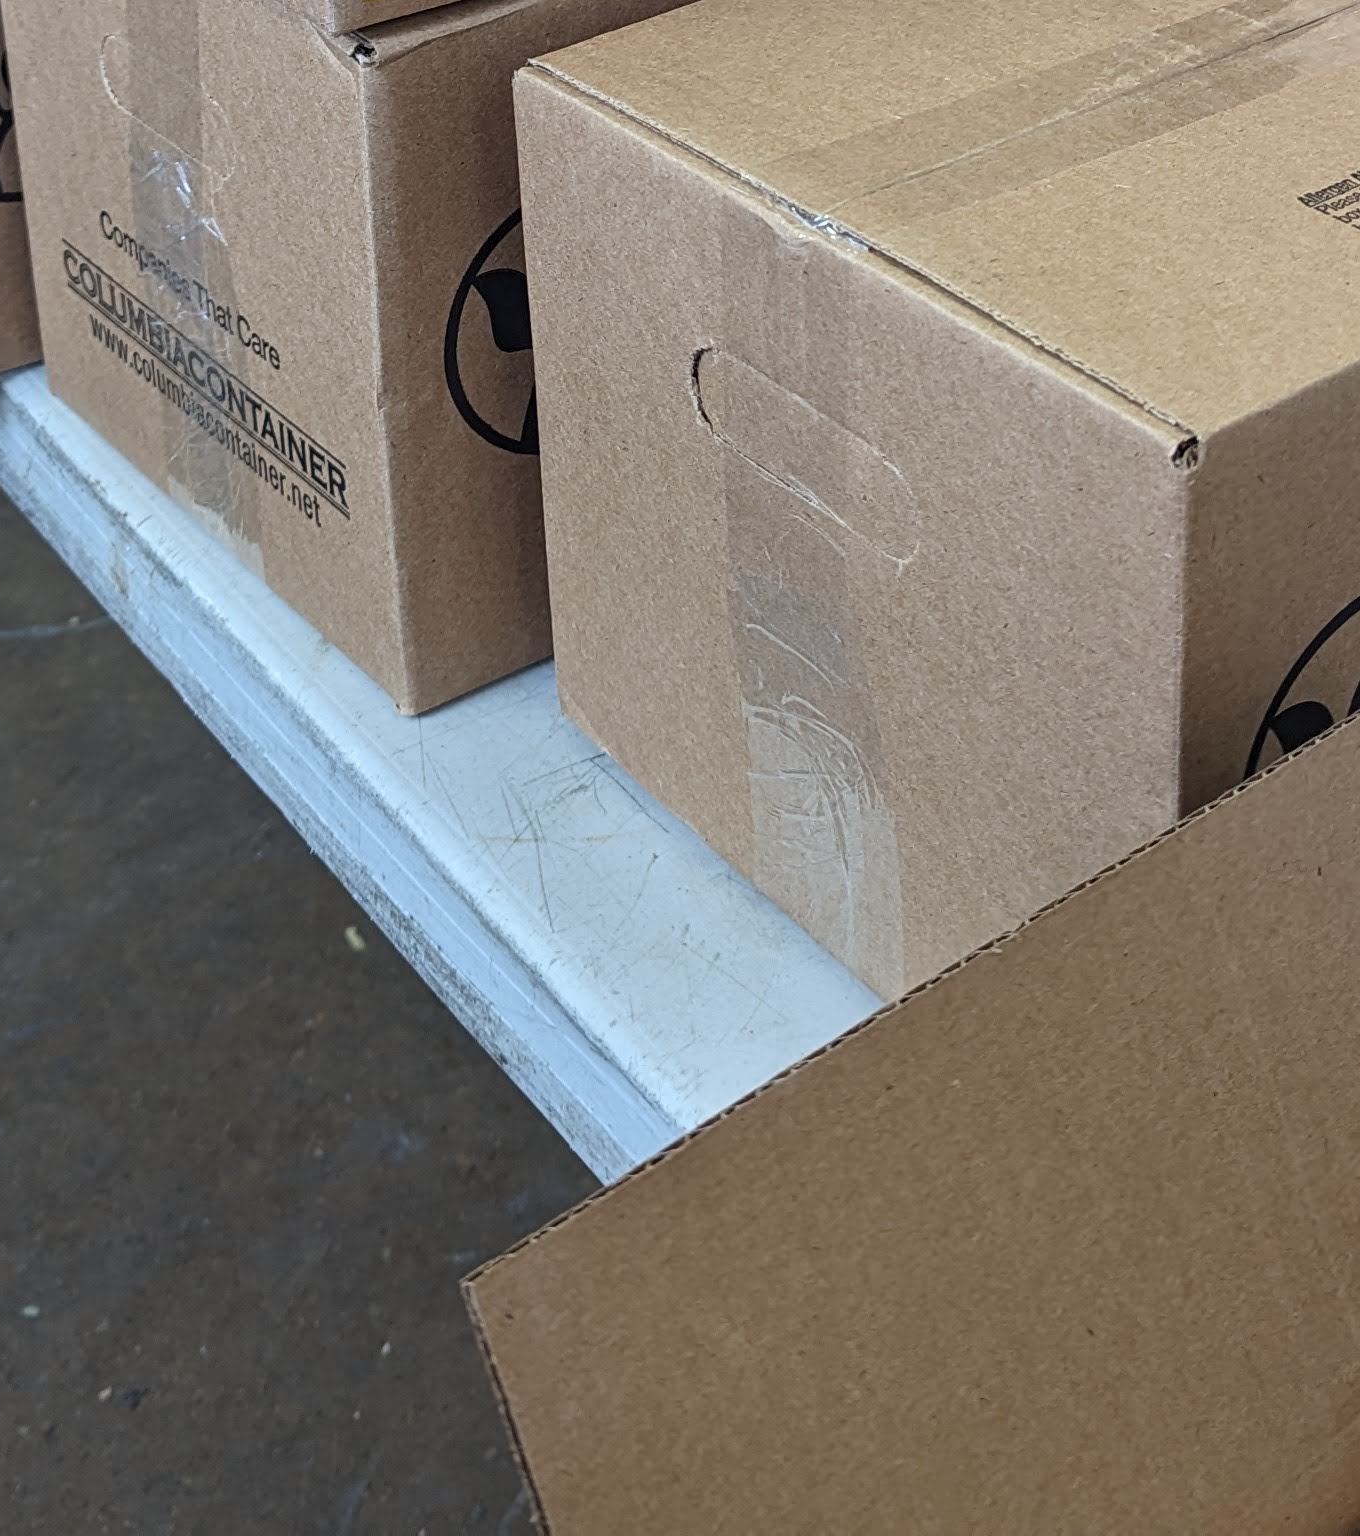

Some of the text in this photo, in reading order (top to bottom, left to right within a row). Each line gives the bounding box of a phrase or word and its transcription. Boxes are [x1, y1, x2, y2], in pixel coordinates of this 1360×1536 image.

[62, 247, 349, 509] COLUMBIACONTAINER
[89, 311, 322, 529] www.columbiacontainer.net
[191, 279, 236, 336] That
[236, 314, 282, 370] Care
